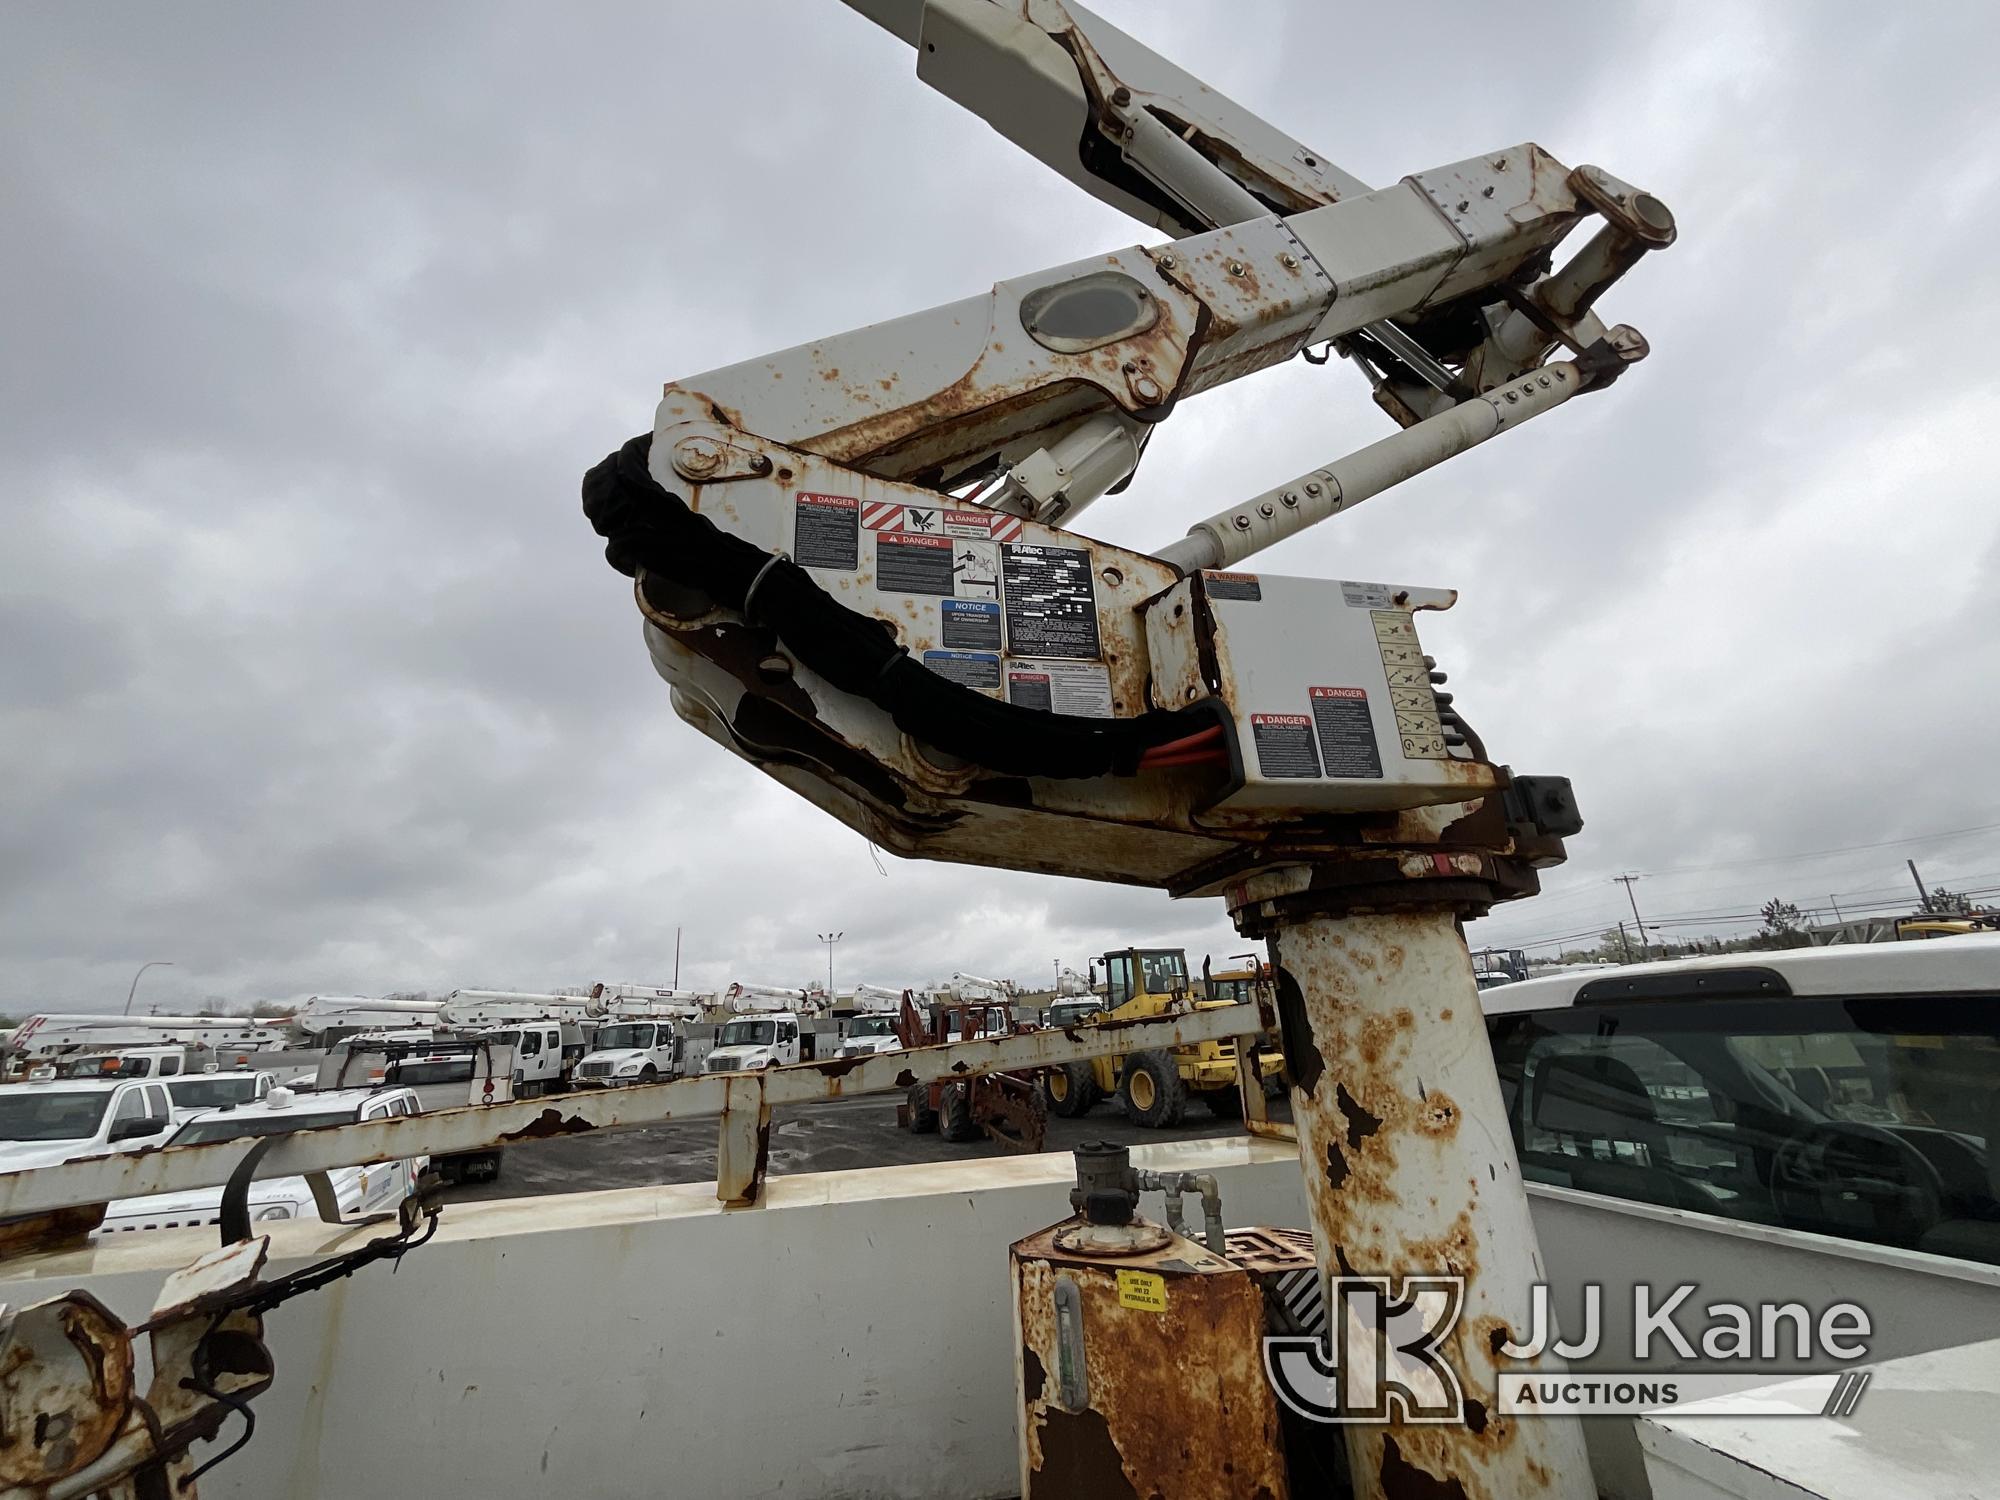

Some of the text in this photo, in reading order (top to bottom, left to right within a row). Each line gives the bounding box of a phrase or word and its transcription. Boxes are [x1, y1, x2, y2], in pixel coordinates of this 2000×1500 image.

[817, 496, 854, 506] DANGER
[955, 515, 988, 524] DANGER
[902, 536, 939, 546] DANGER
[1218, 574, 1257, 582] WARNING
[955, 603, 987, 611] NOTICE
[1327, 689, 1363, 697] DANGER
[1267, 715, 1306, 724] DANGER
[1125, 1294, 1151, 1303] HYDRAULIC
